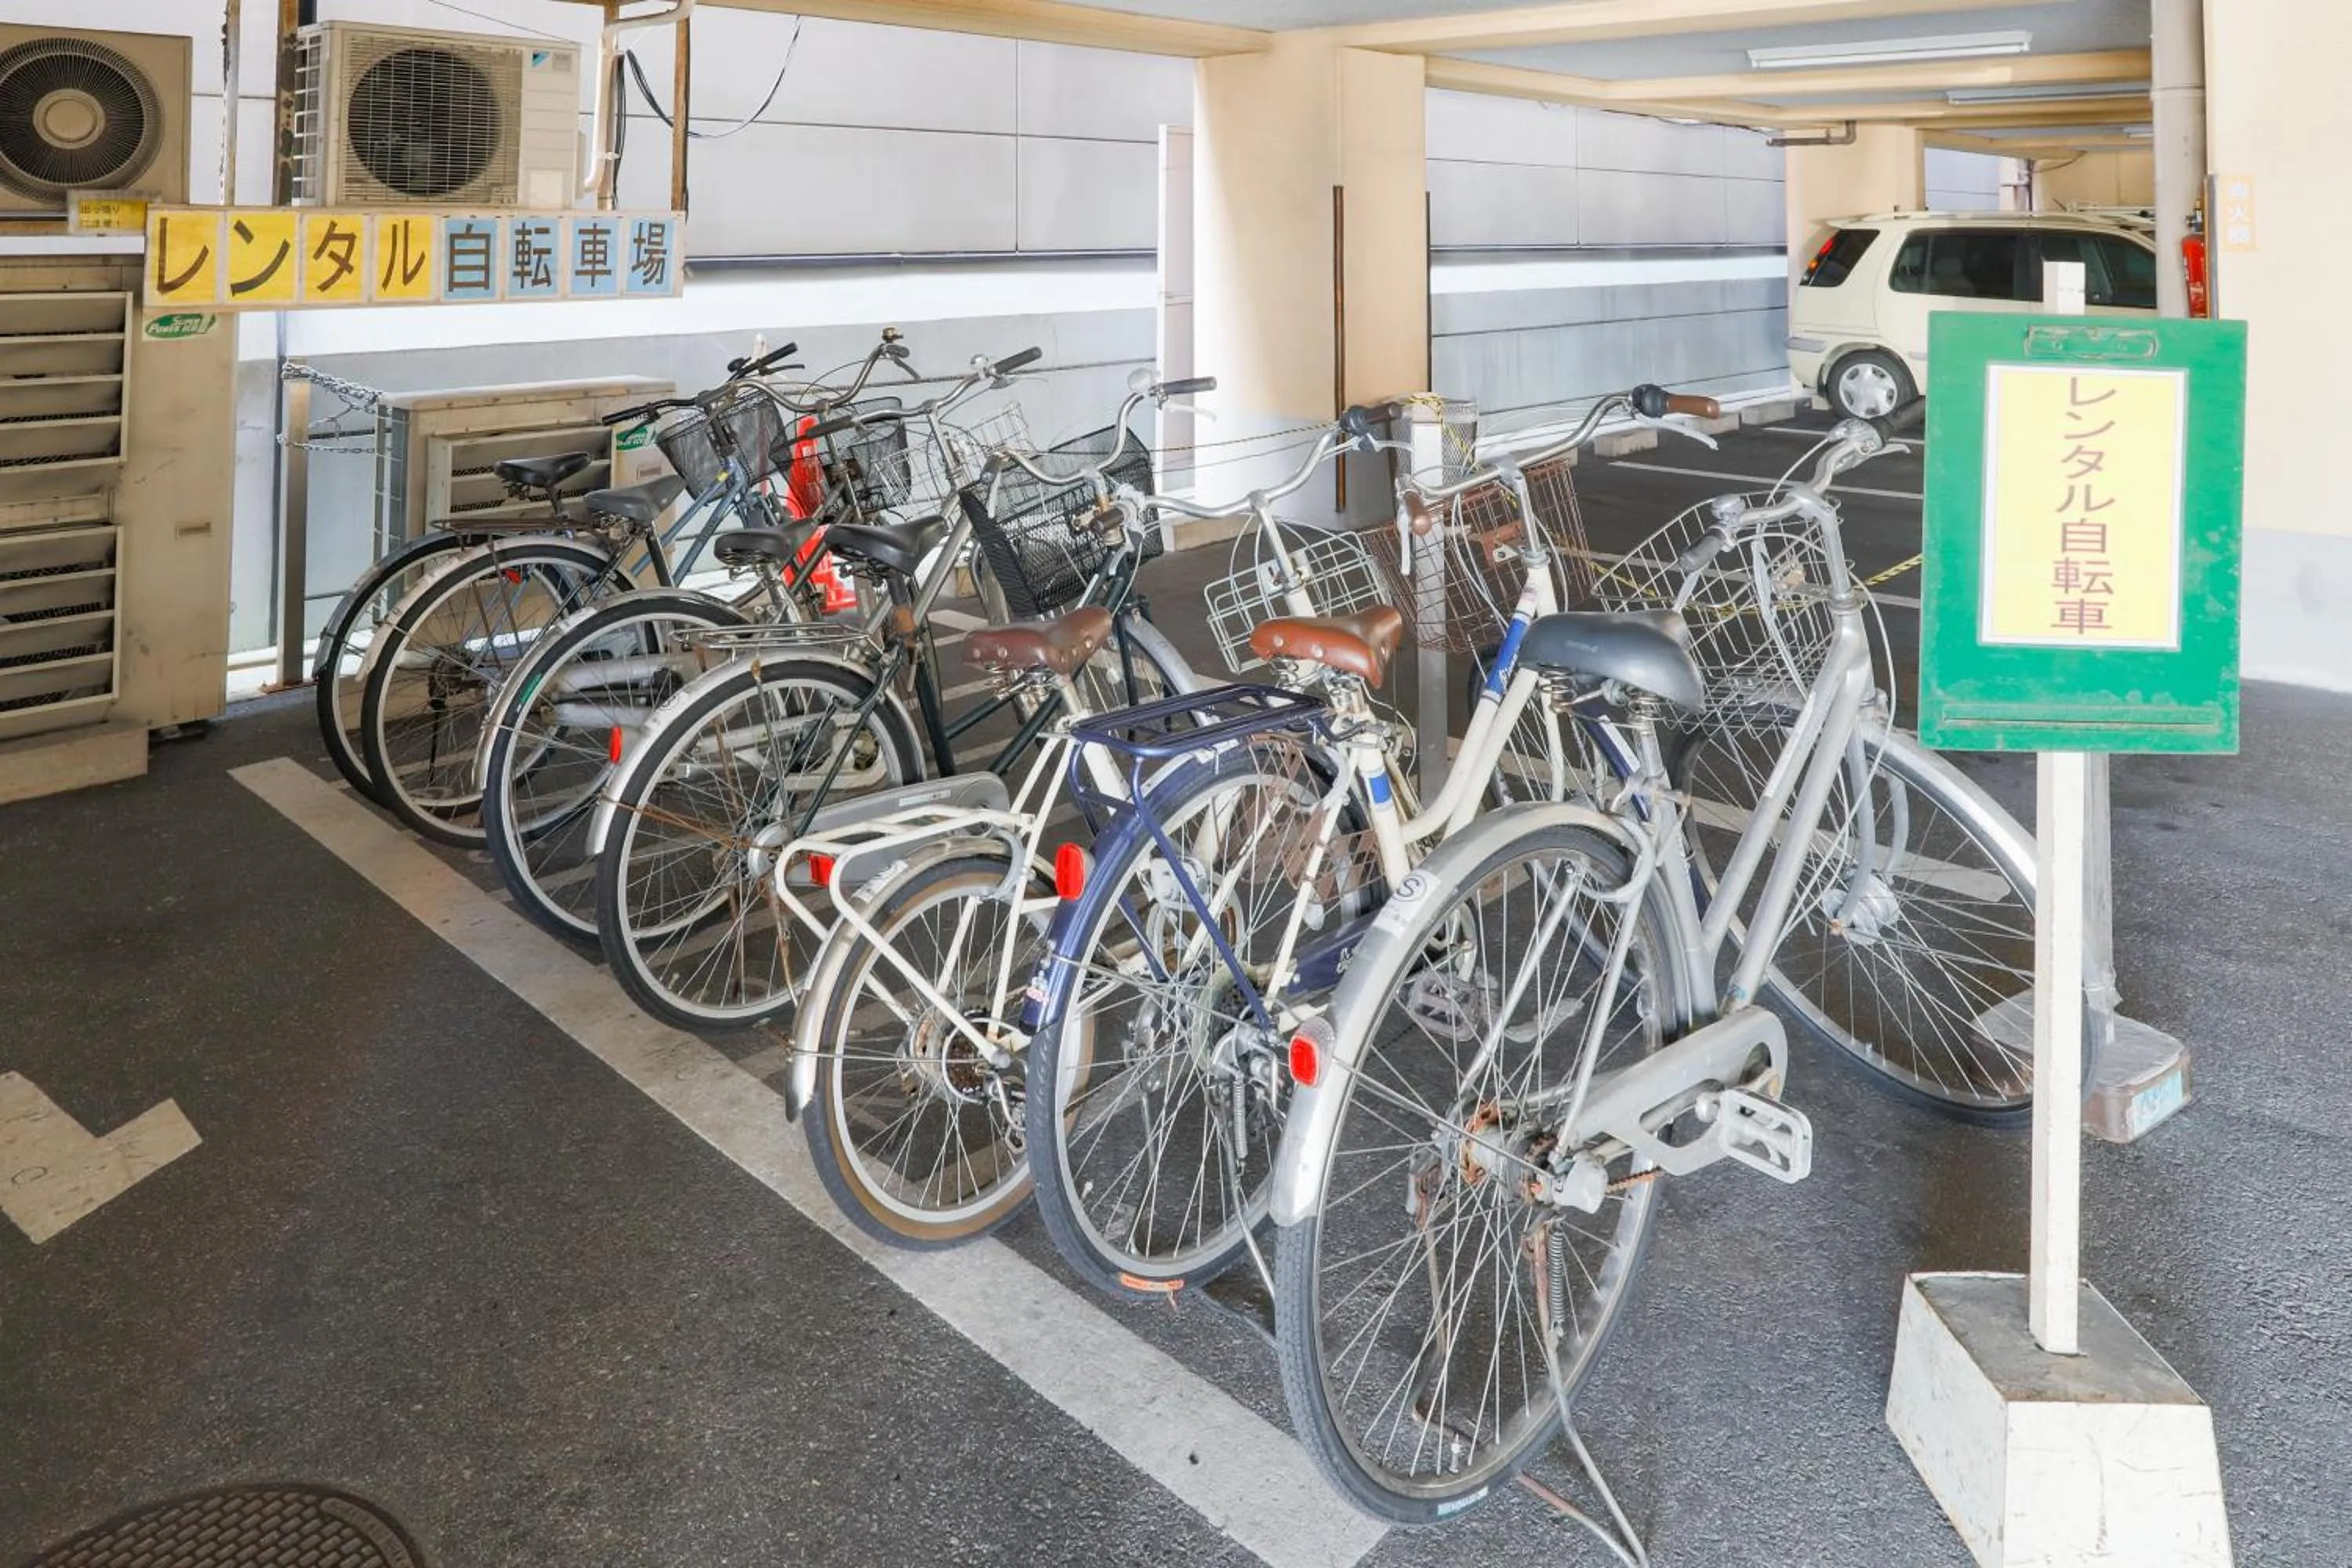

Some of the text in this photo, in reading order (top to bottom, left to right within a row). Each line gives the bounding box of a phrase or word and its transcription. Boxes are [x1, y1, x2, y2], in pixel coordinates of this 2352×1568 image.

[157, 217, 667, 297] レンタル自転車場
[2050, 376, 2116, 635] レンタル自転車
